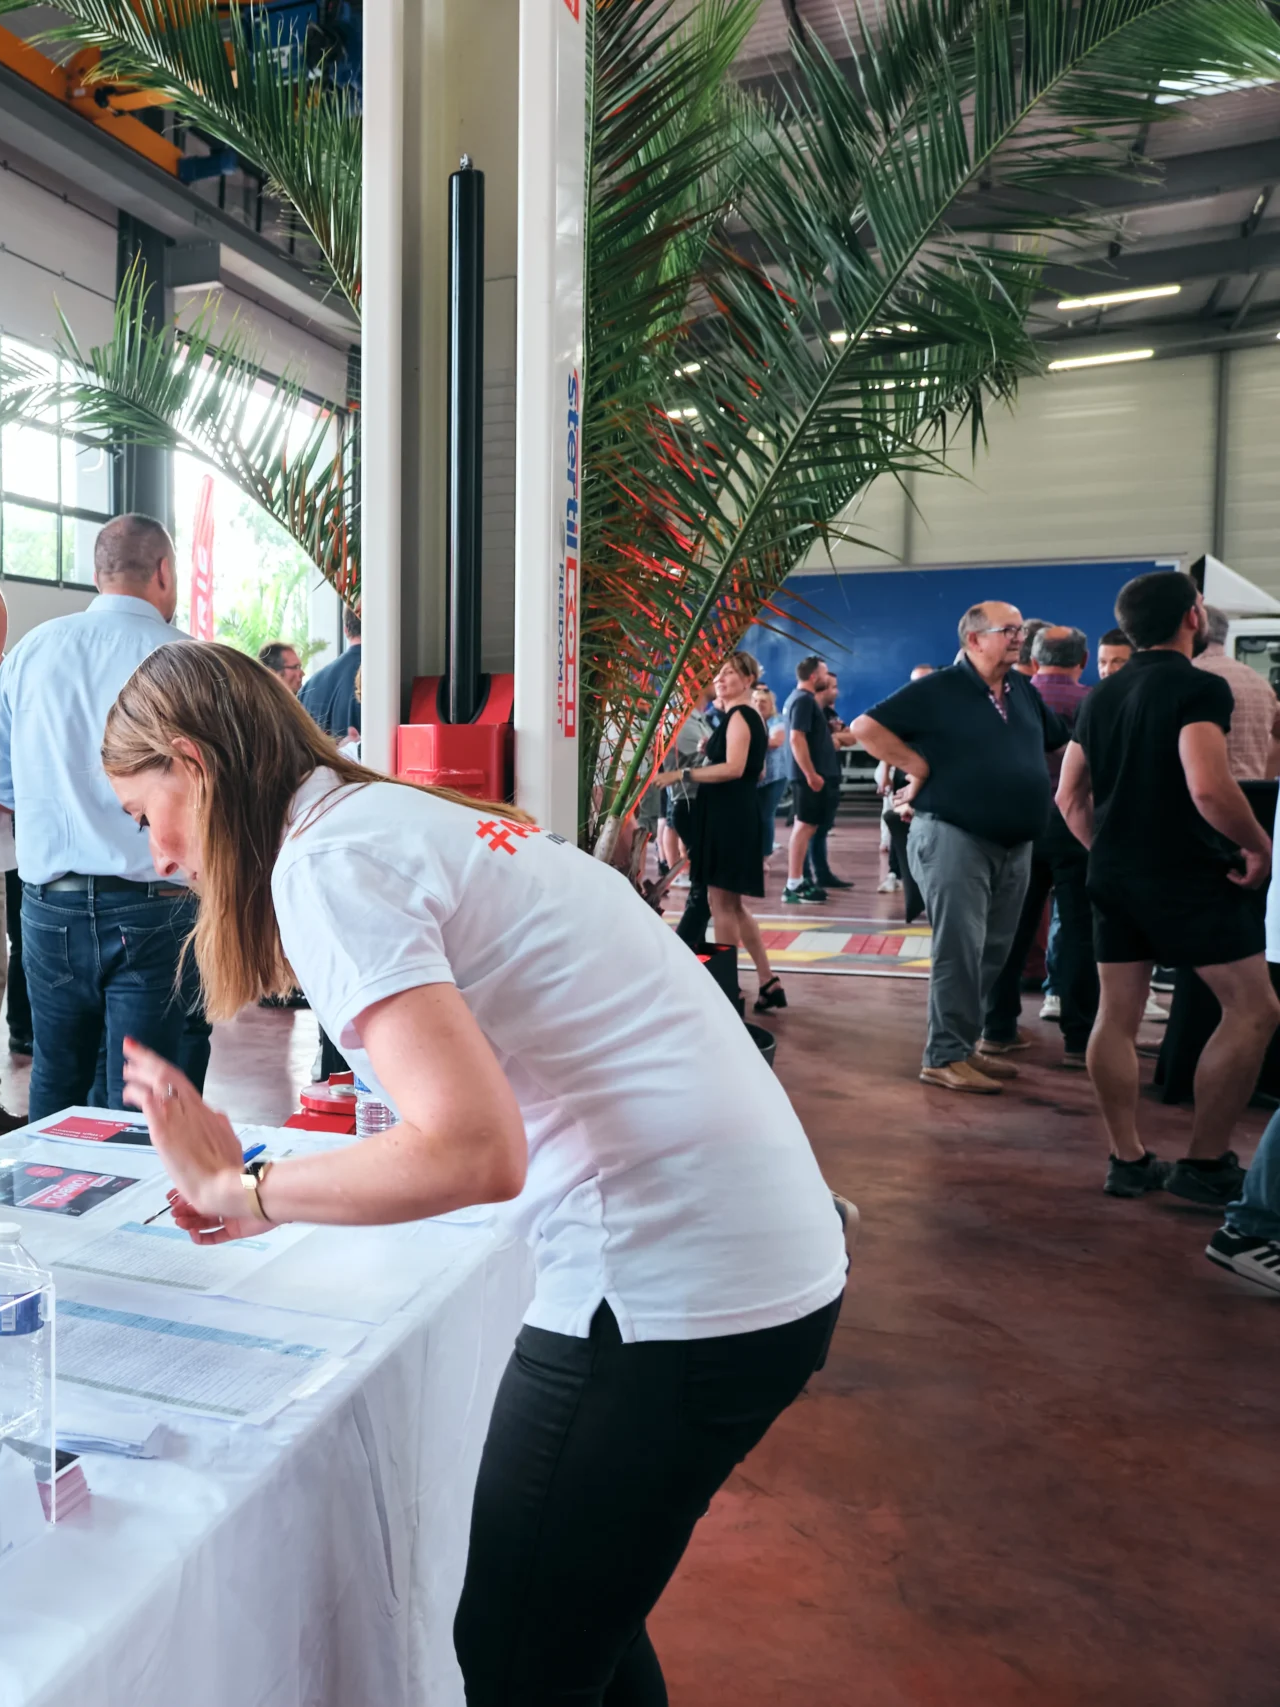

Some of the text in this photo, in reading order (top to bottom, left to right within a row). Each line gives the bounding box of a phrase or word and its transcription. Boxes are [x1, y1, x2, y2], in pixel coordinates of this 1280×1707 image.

[566, 372, 579, 728] stertil KONI
[557, 562, 565, 730] FREEDOMLIFT
[39, 1177, 93, 1204] TOMBOLA
